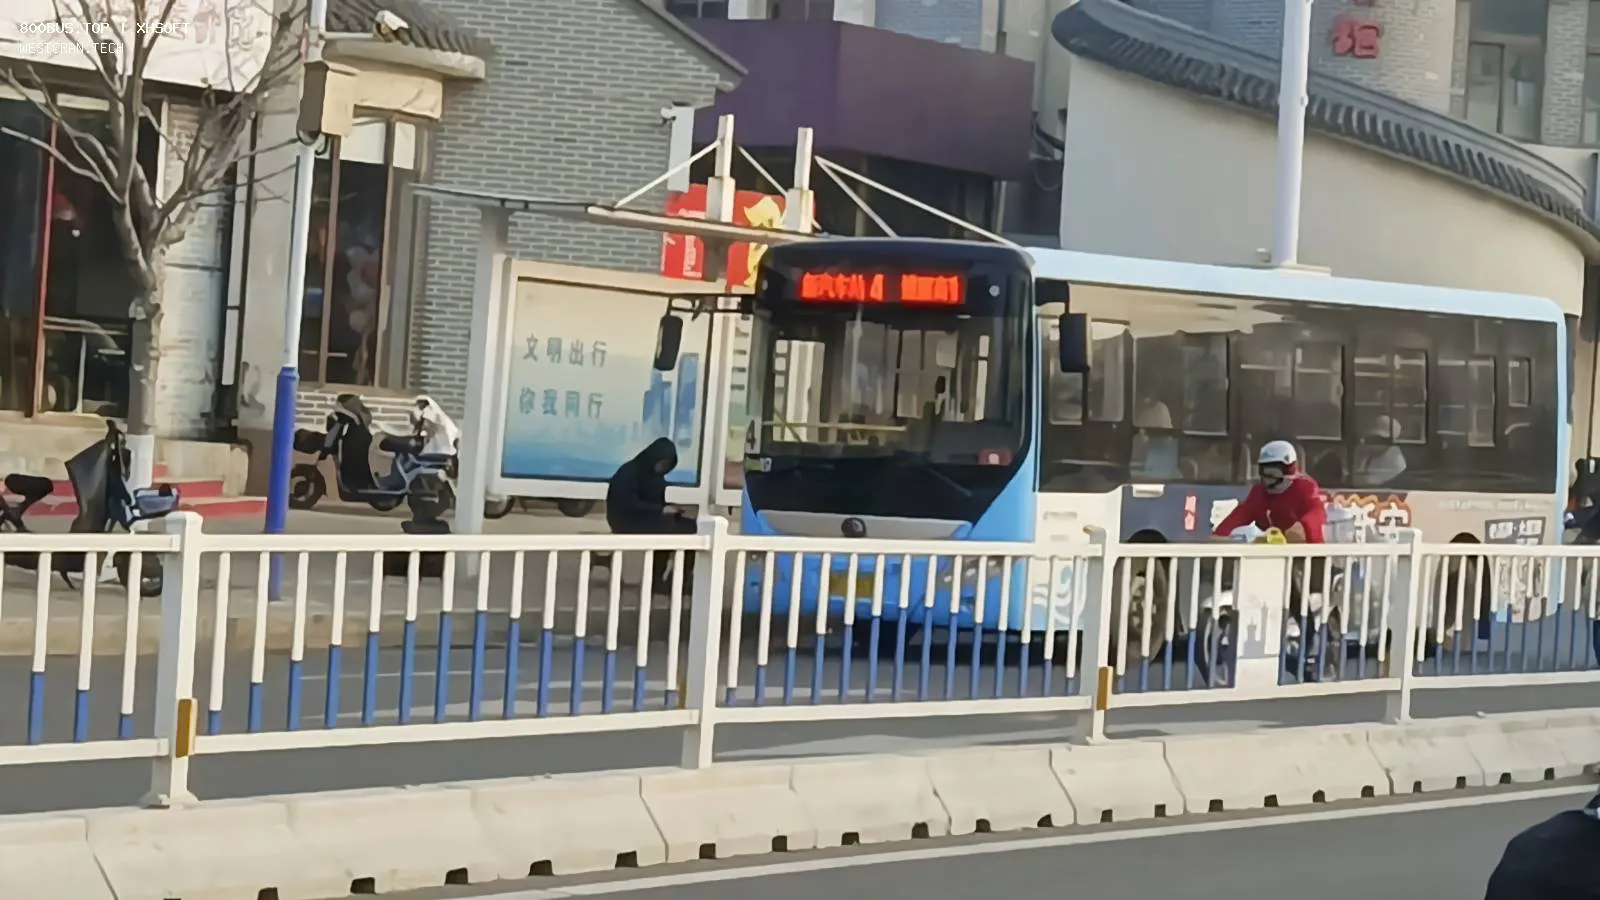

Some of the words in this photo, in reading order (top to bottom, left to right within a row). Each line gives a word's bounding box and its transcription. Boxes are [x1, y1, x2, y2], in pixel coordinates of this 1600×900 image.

[522, 333, 608, 368] 文明出行
[519, 386, 604, 420] 你我同行
